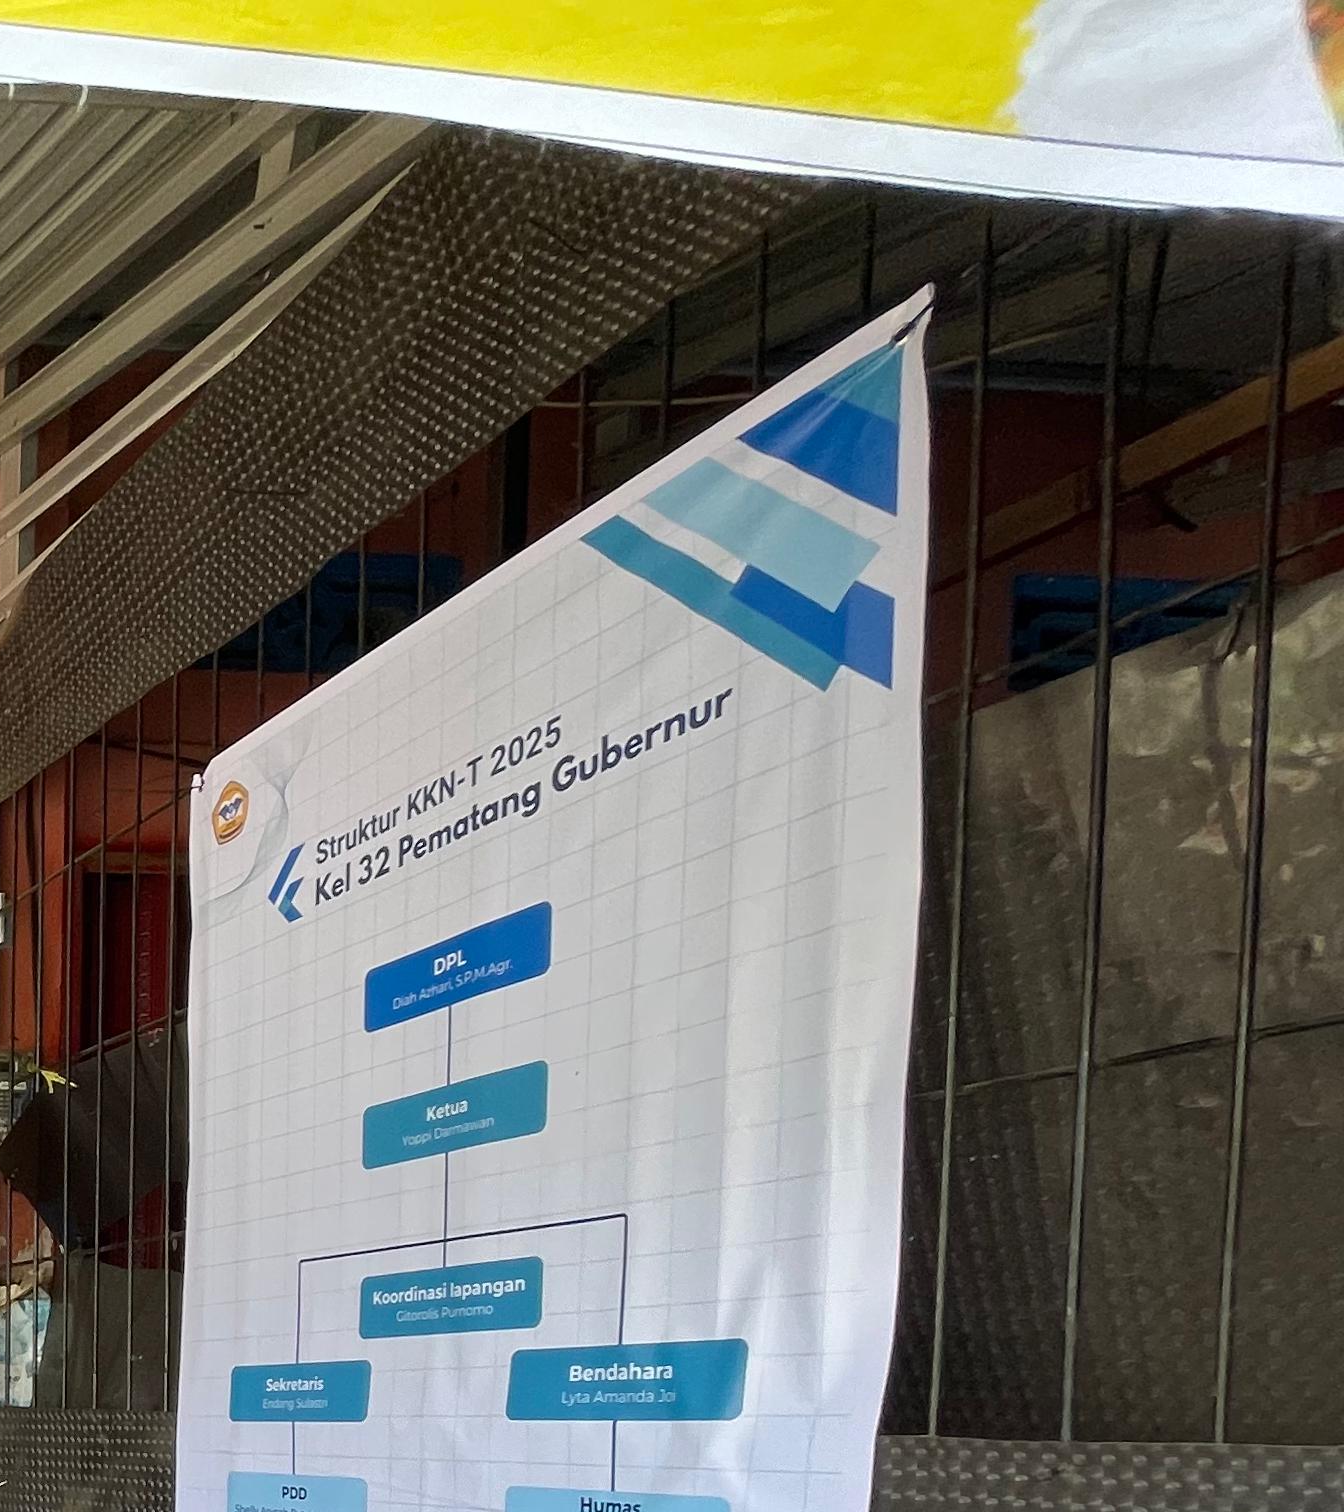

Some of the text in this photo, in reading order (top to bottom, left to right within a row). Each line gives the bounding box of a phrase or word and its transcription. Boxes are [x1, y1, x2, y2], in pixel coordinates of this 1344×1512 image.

[314, 714, 562, 865] Struktur KKN-T 2025
[314, 687, 734, 906] Kel 32 Pematang Gubernur
[433, 949, 467, 976] DPL
[425, 1099, 469, 1122] Ketua
[372, 1277, 527, 1305] Koordinasi lapangan
[265, 1375, 325, 1392] Sekretaris
[568, 1362, 674, 1382] Bendahara
[592, 1388, 655, 1404] Amanda
[281, 1486, 308, 1500] PDD
